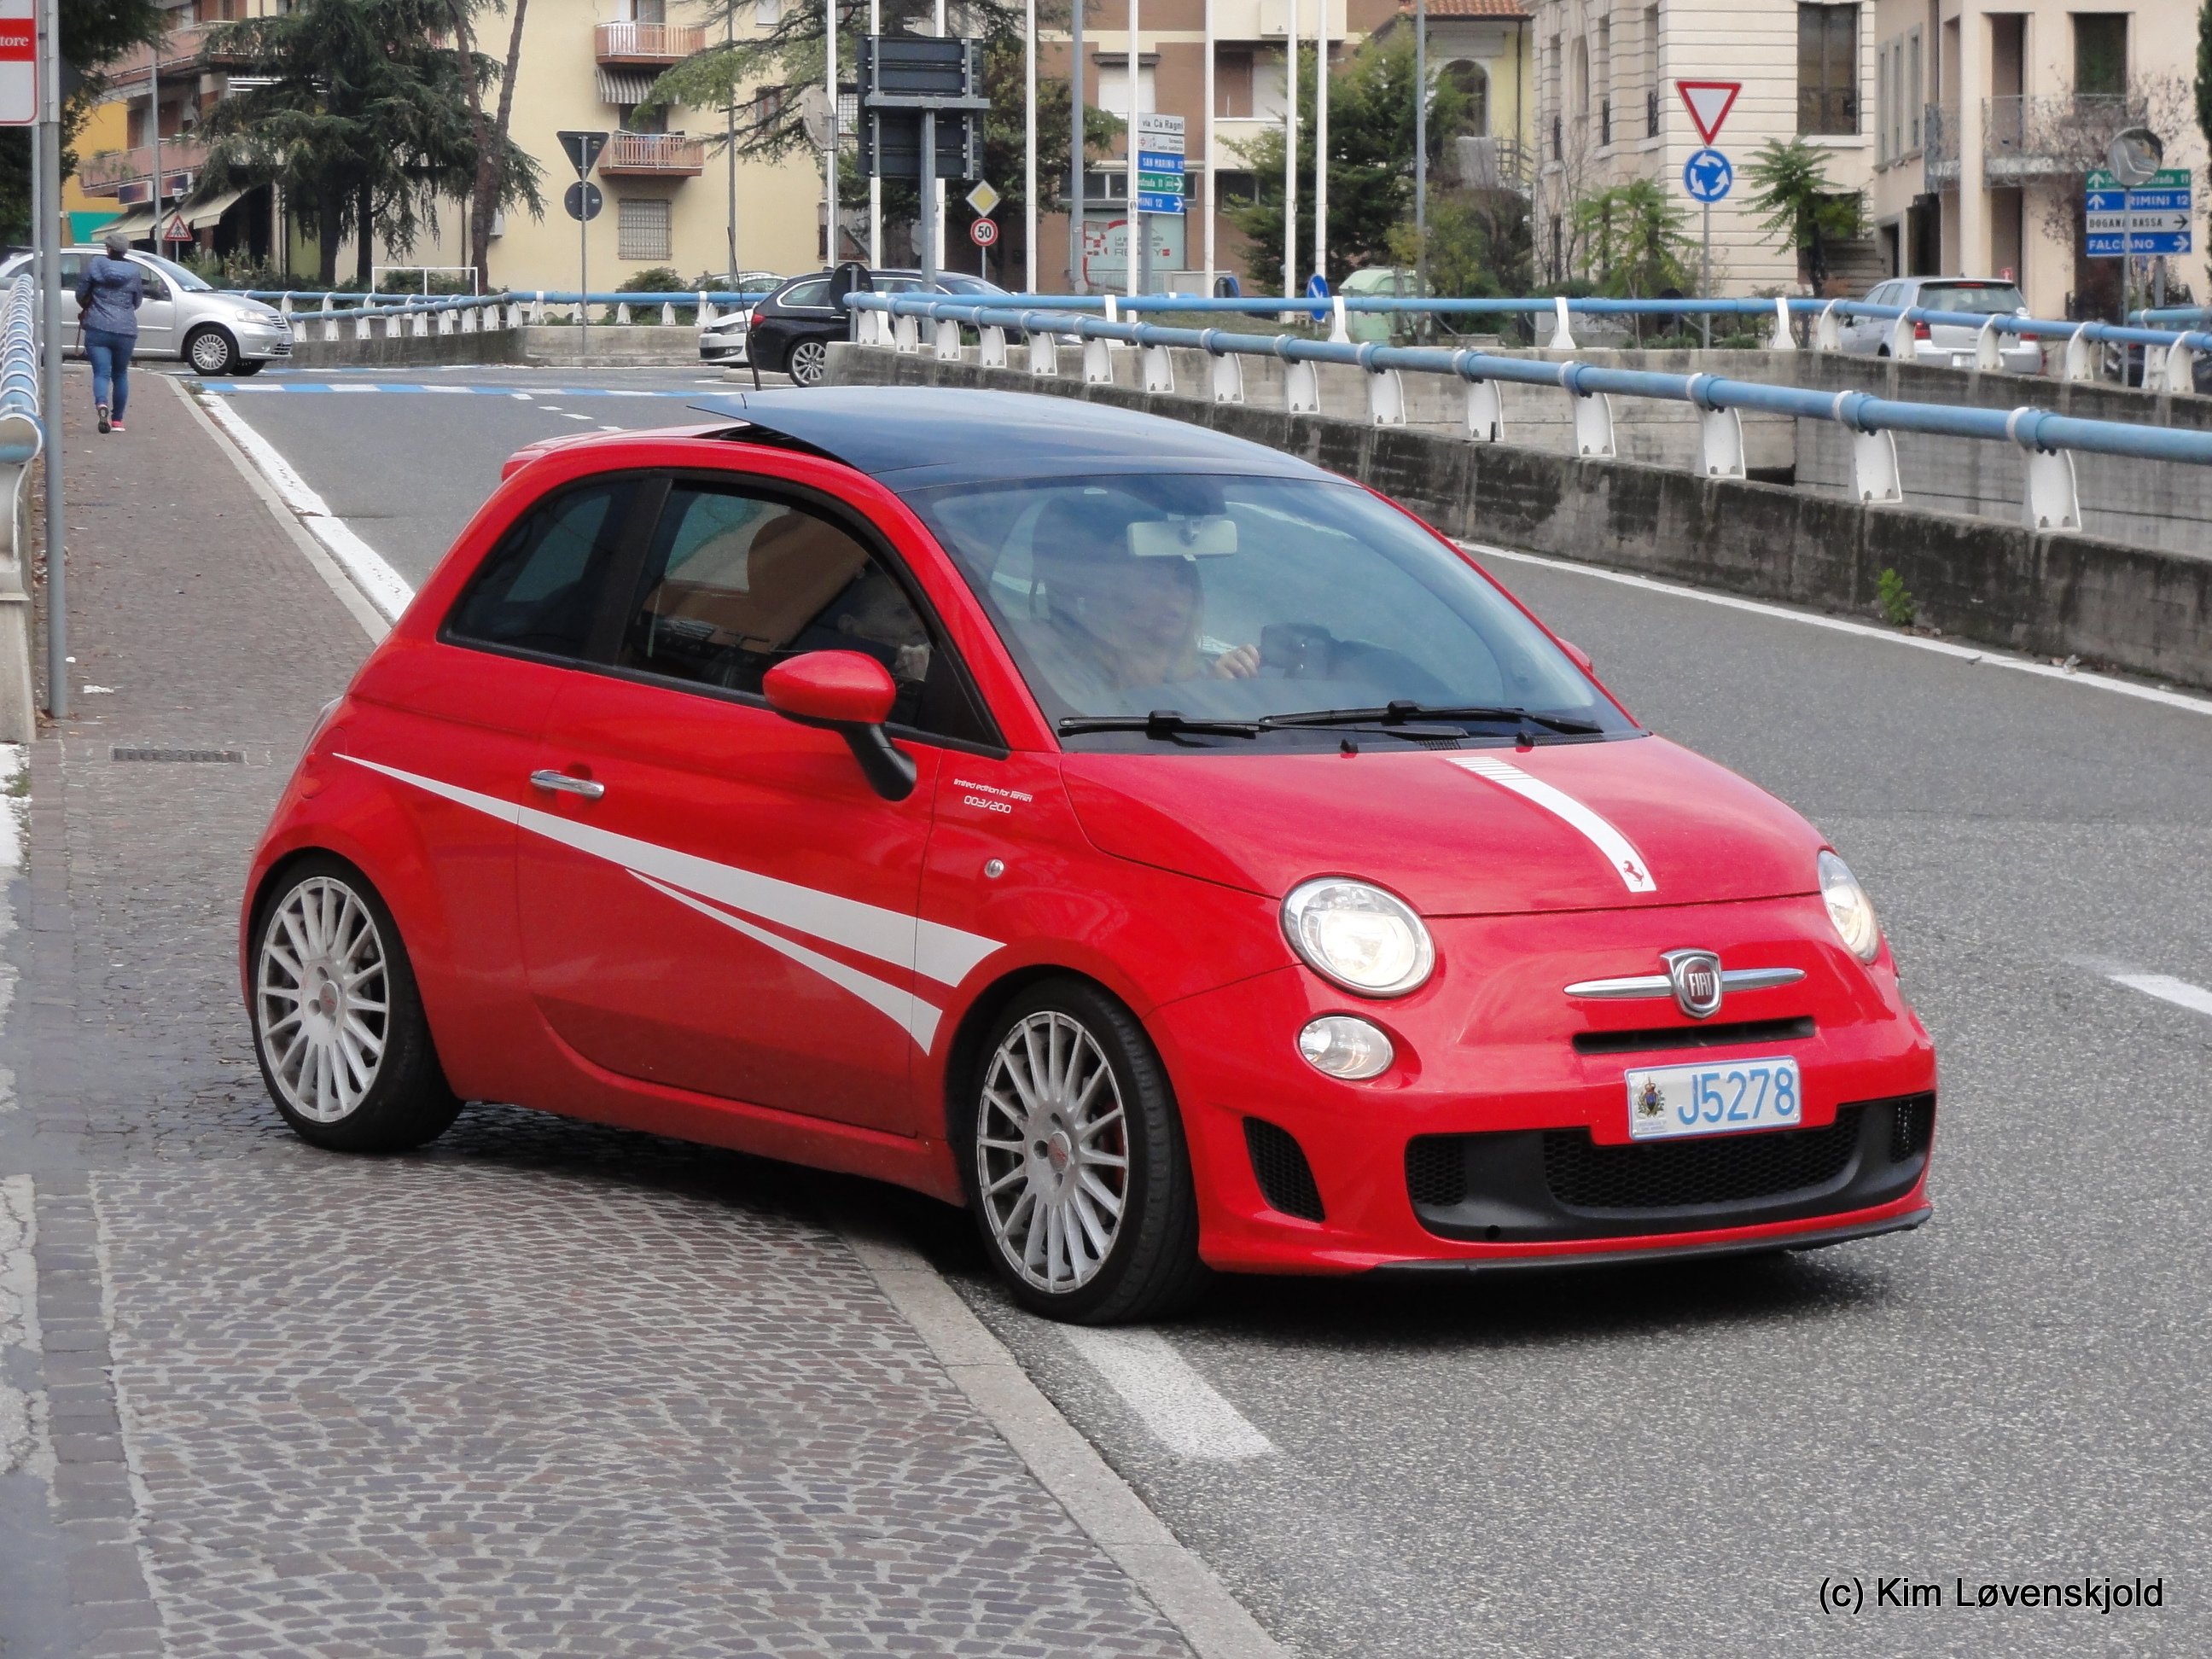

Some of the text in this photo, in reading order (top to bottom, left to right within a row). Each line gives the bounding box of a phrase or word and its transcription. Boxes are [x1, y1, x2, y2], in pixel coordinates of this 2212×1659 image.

[1155, 198, 1162, 208] 12
[2176, 195, 2189, 206] 12
[2132, 218, 2163, 228] BASSA
[978, 225, 992, 239] 50
[953, 778, 975, 789] limited
[975, 784, 999, 795] edition
[999, 789, 1010, 797] for
[963, 795, 1012, 814] 003/200
[1688, 972, 1713, 997] FIAT
[1677, 1067, 1795, 1126] J5278
